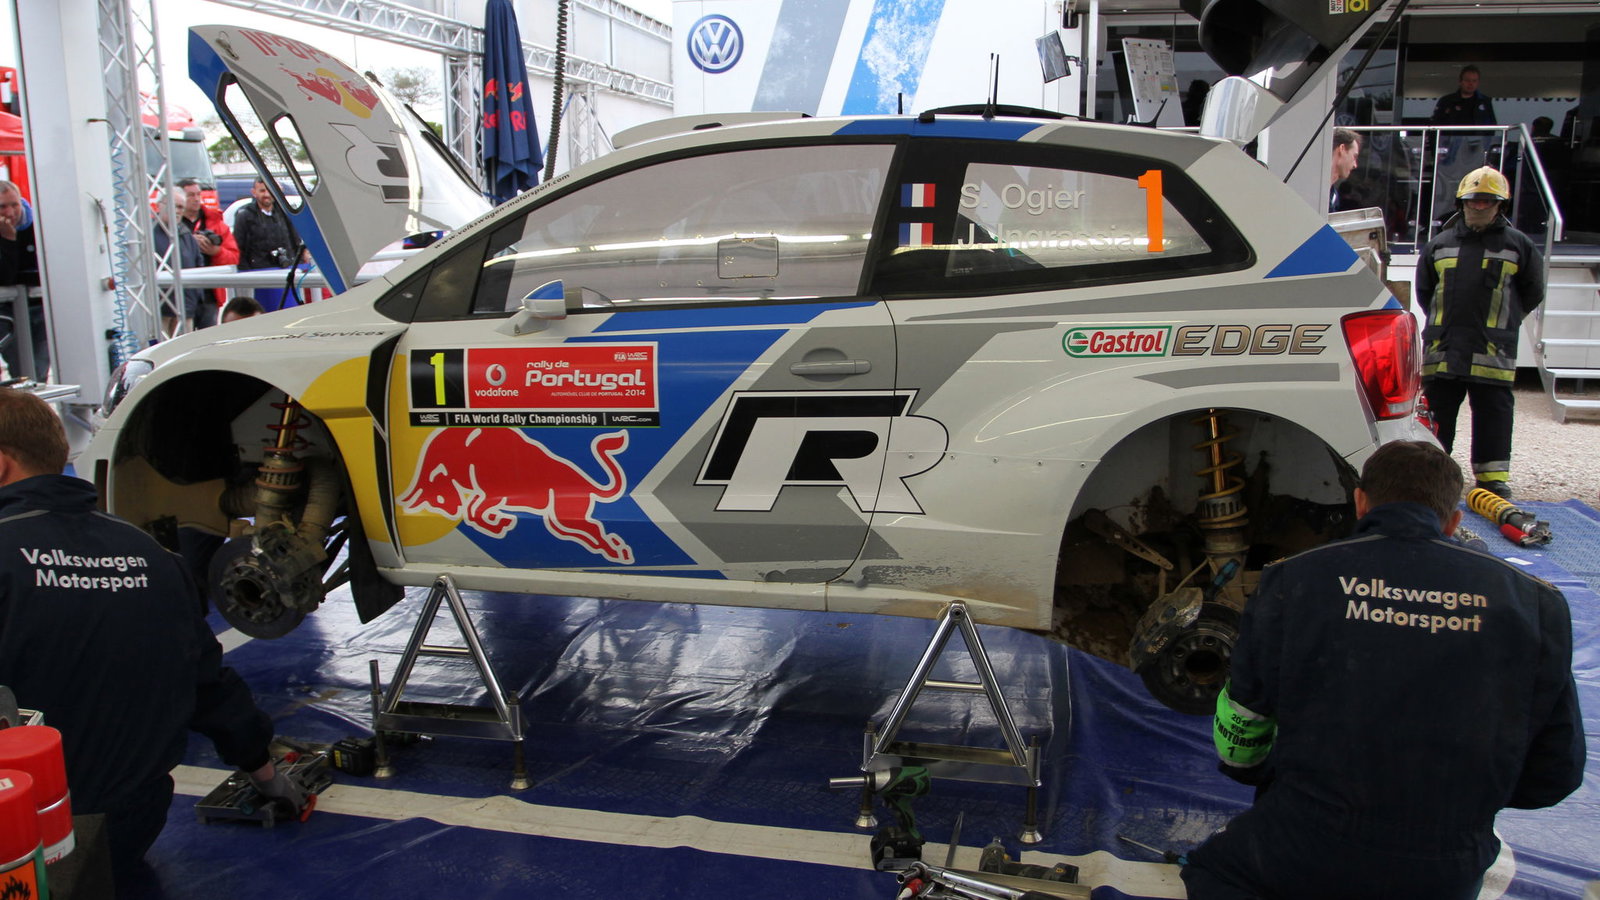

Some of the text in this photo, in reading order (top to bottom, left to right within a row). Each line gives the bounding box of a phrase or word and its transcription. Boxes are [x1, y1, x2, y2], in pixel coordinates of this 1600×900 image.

[434, 173, 571, 250] www.volkswagen-motorsport.com
[959, 183, 1086, 216] S. Ogier
[1137, 169, 1164, 253] 1
[998, 223, 1136, 256] Ingrassia
[312, 329, 385, 338] Services
[1089, 324, 1332, 356] Castrol EDGE
[430, 352, 446, 406] 1
[525, 369, 646, 390] Portugal
[527, 361, 553, 370] rally
[475, 388, 519, 397] vodafone
[625, 389, 646, 397] 2014
[454, 414, 597, 425] FIA World Rally Championship
[693, 388, 950, 515] R
[20, 547, 148, 572] Volkswagen
[36, 568, 148, 592] Motorsport
[1338, 576, 1488, 611] Volkswagen
[1345, 600, 1482, 634] Motorsport
